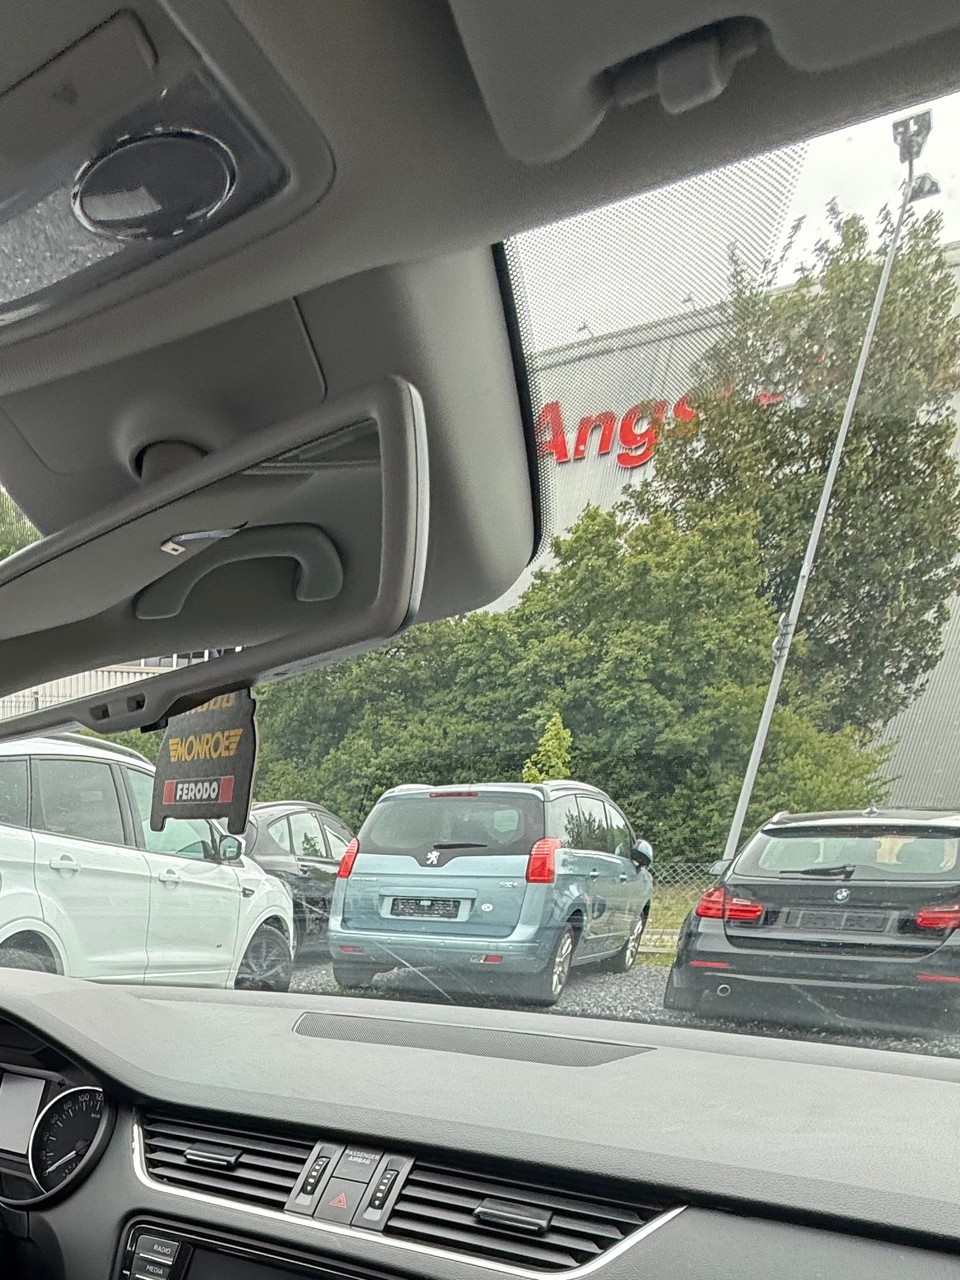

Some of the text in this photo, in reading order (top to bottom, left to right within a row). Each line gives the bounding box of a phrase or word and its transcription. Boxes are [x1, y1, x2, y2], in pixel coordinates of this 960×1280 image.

[174, 731, 231, 762] MONROE
[175, 781, 218, 800] FERODO
[345, 1149, 381, 1161] PASSENGER
[153, 1244, 172, 1255] RADIO
[145, 1264, 164, 1275] MEDIA
